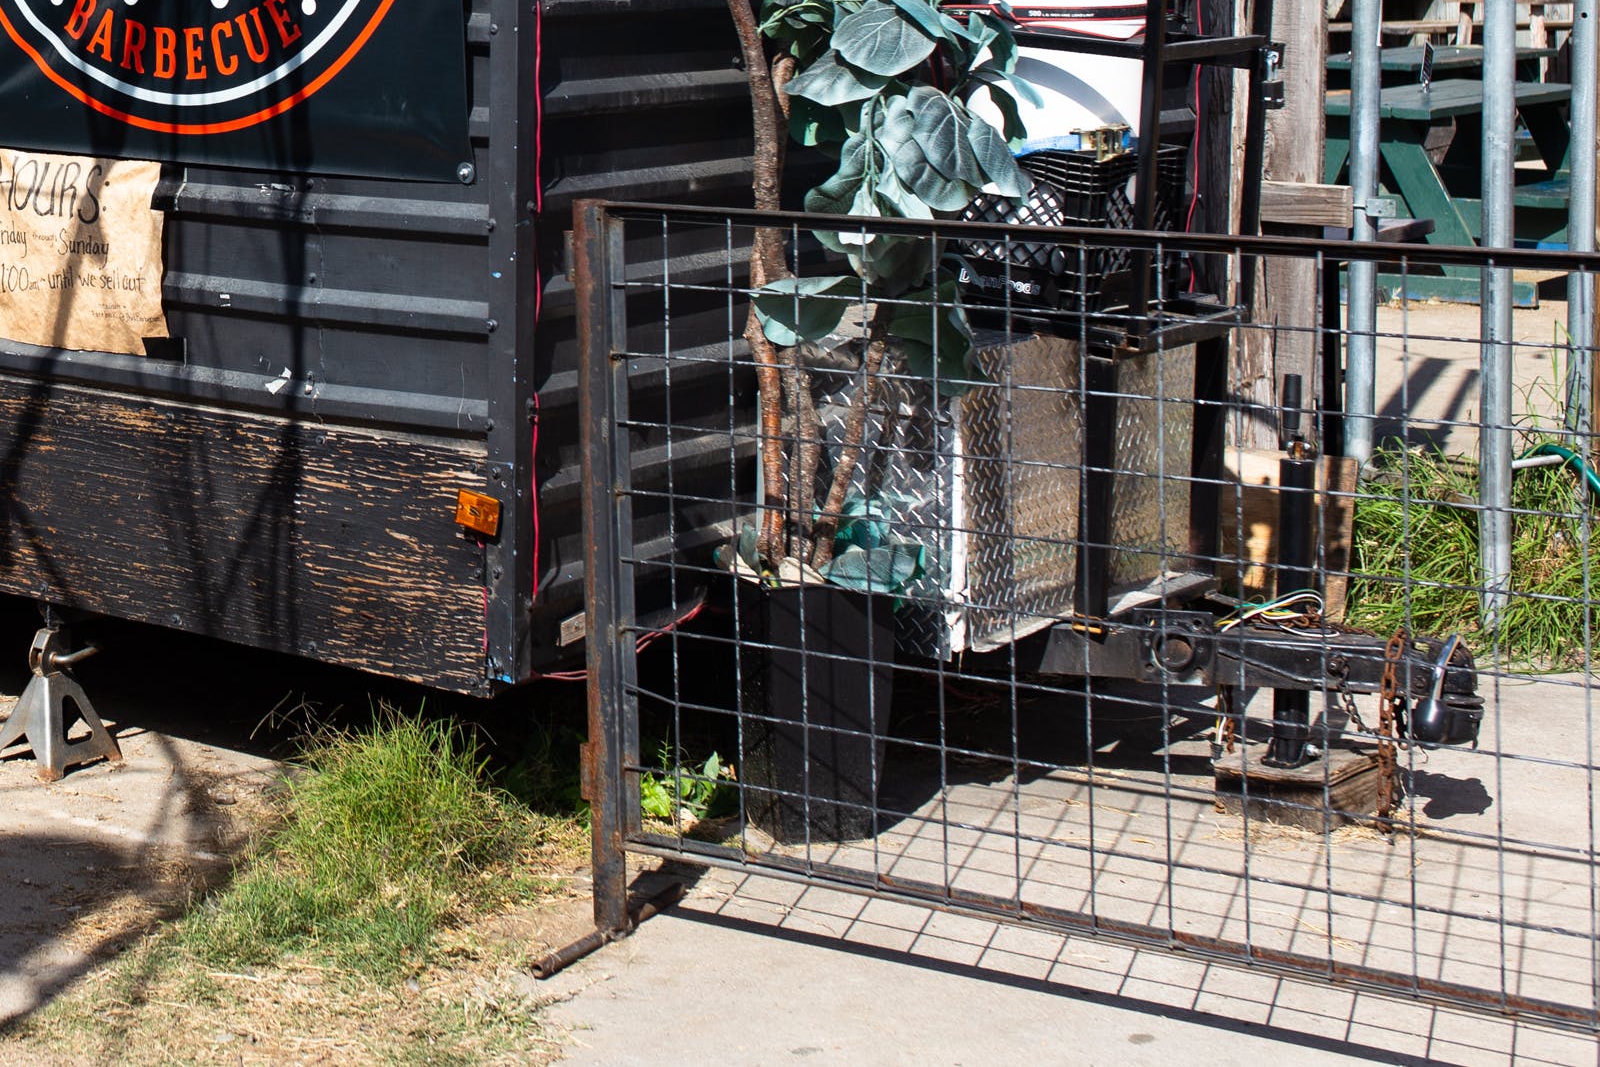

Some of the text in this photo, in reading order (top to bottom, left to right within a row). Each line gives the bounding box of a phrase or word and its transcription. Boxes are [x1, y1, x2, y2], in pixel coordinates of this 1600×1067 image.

[57, 228, 109, 269] Sunday
[48, 266, 73, 290] until
[79, 274, 96, 287] we
[99, 267, 120, 290] sell
[122, 271, 146, 292] out
